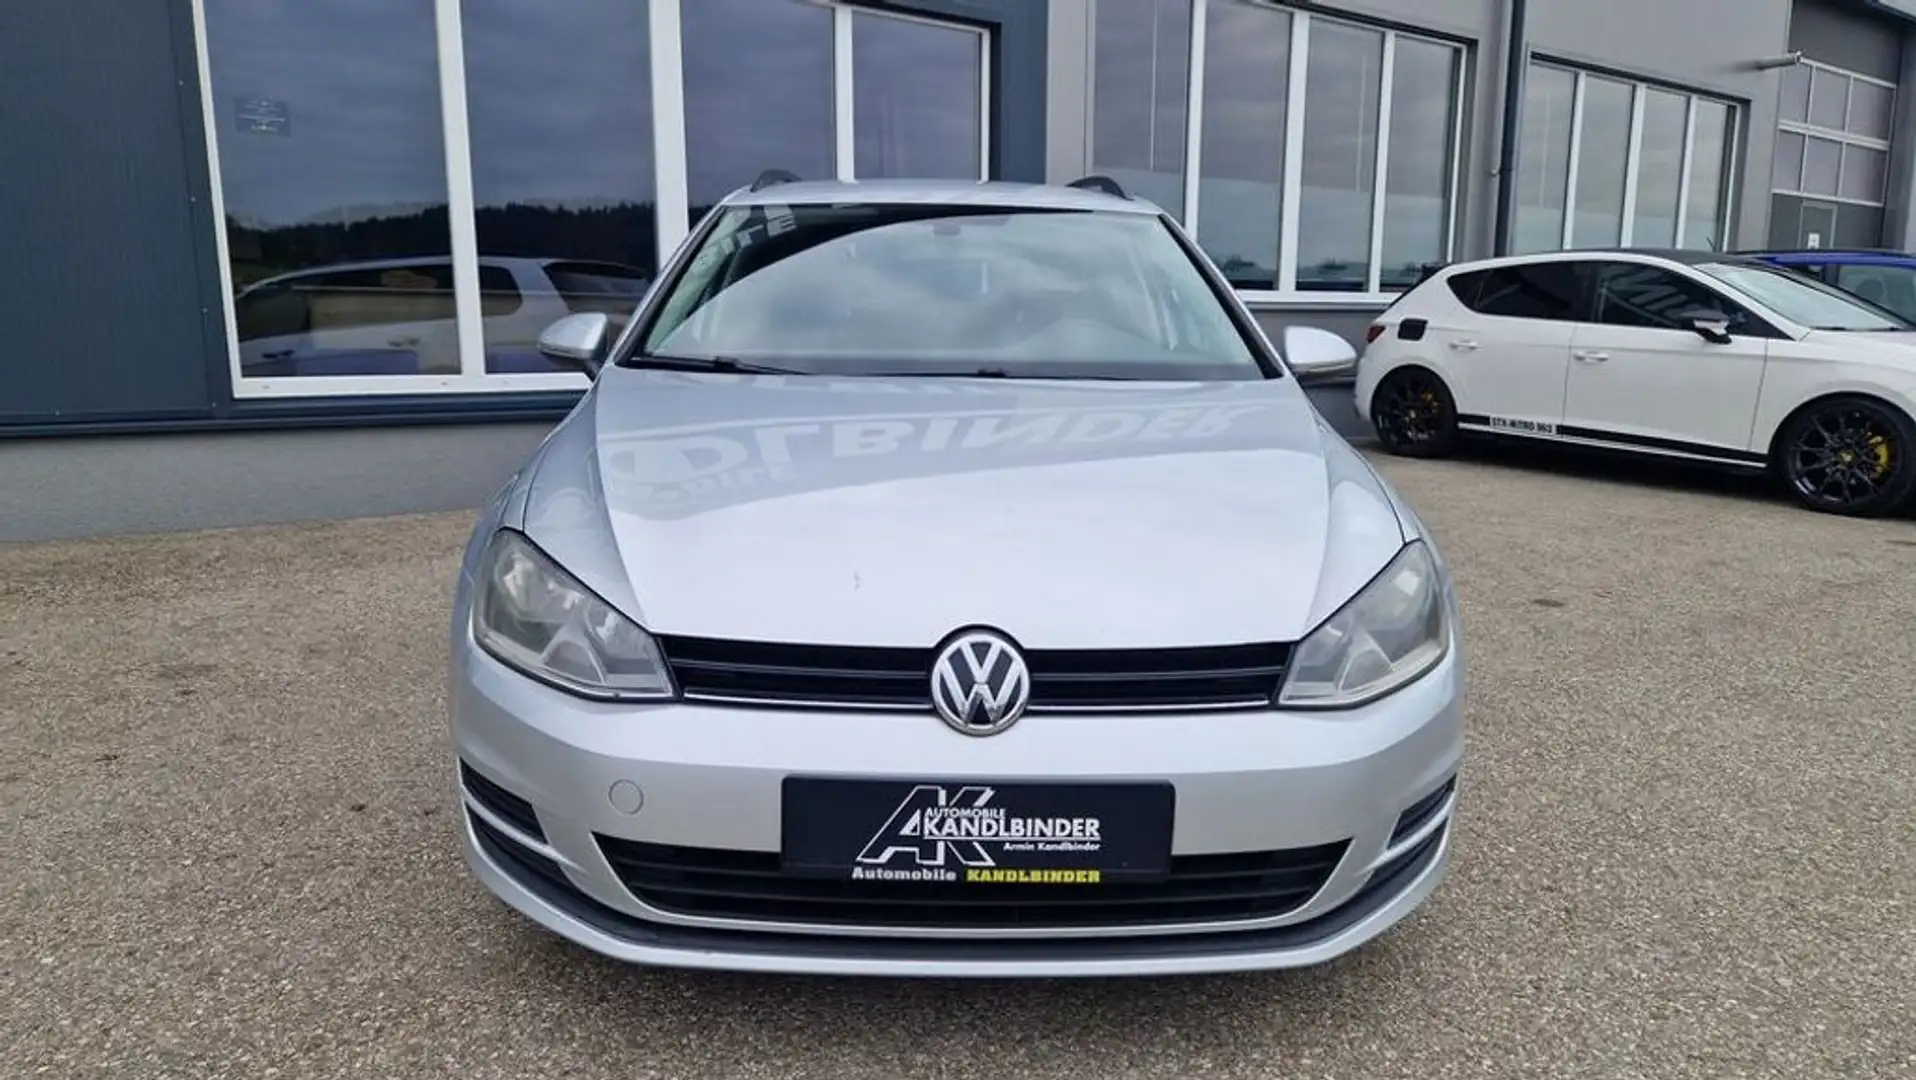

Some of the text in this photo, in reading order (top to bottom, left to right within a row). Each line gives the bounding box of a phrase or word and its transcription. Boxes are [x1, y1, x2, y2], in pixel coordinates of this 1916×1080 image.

[924, 807, 1006, 819] AUTOMOBILE
[923, 817, 1100, 837] KANDLBINDER
[1003, 842, 1035, 852] Armin
[852, 866, 1100, 883] Automobile KANDLBINDER
